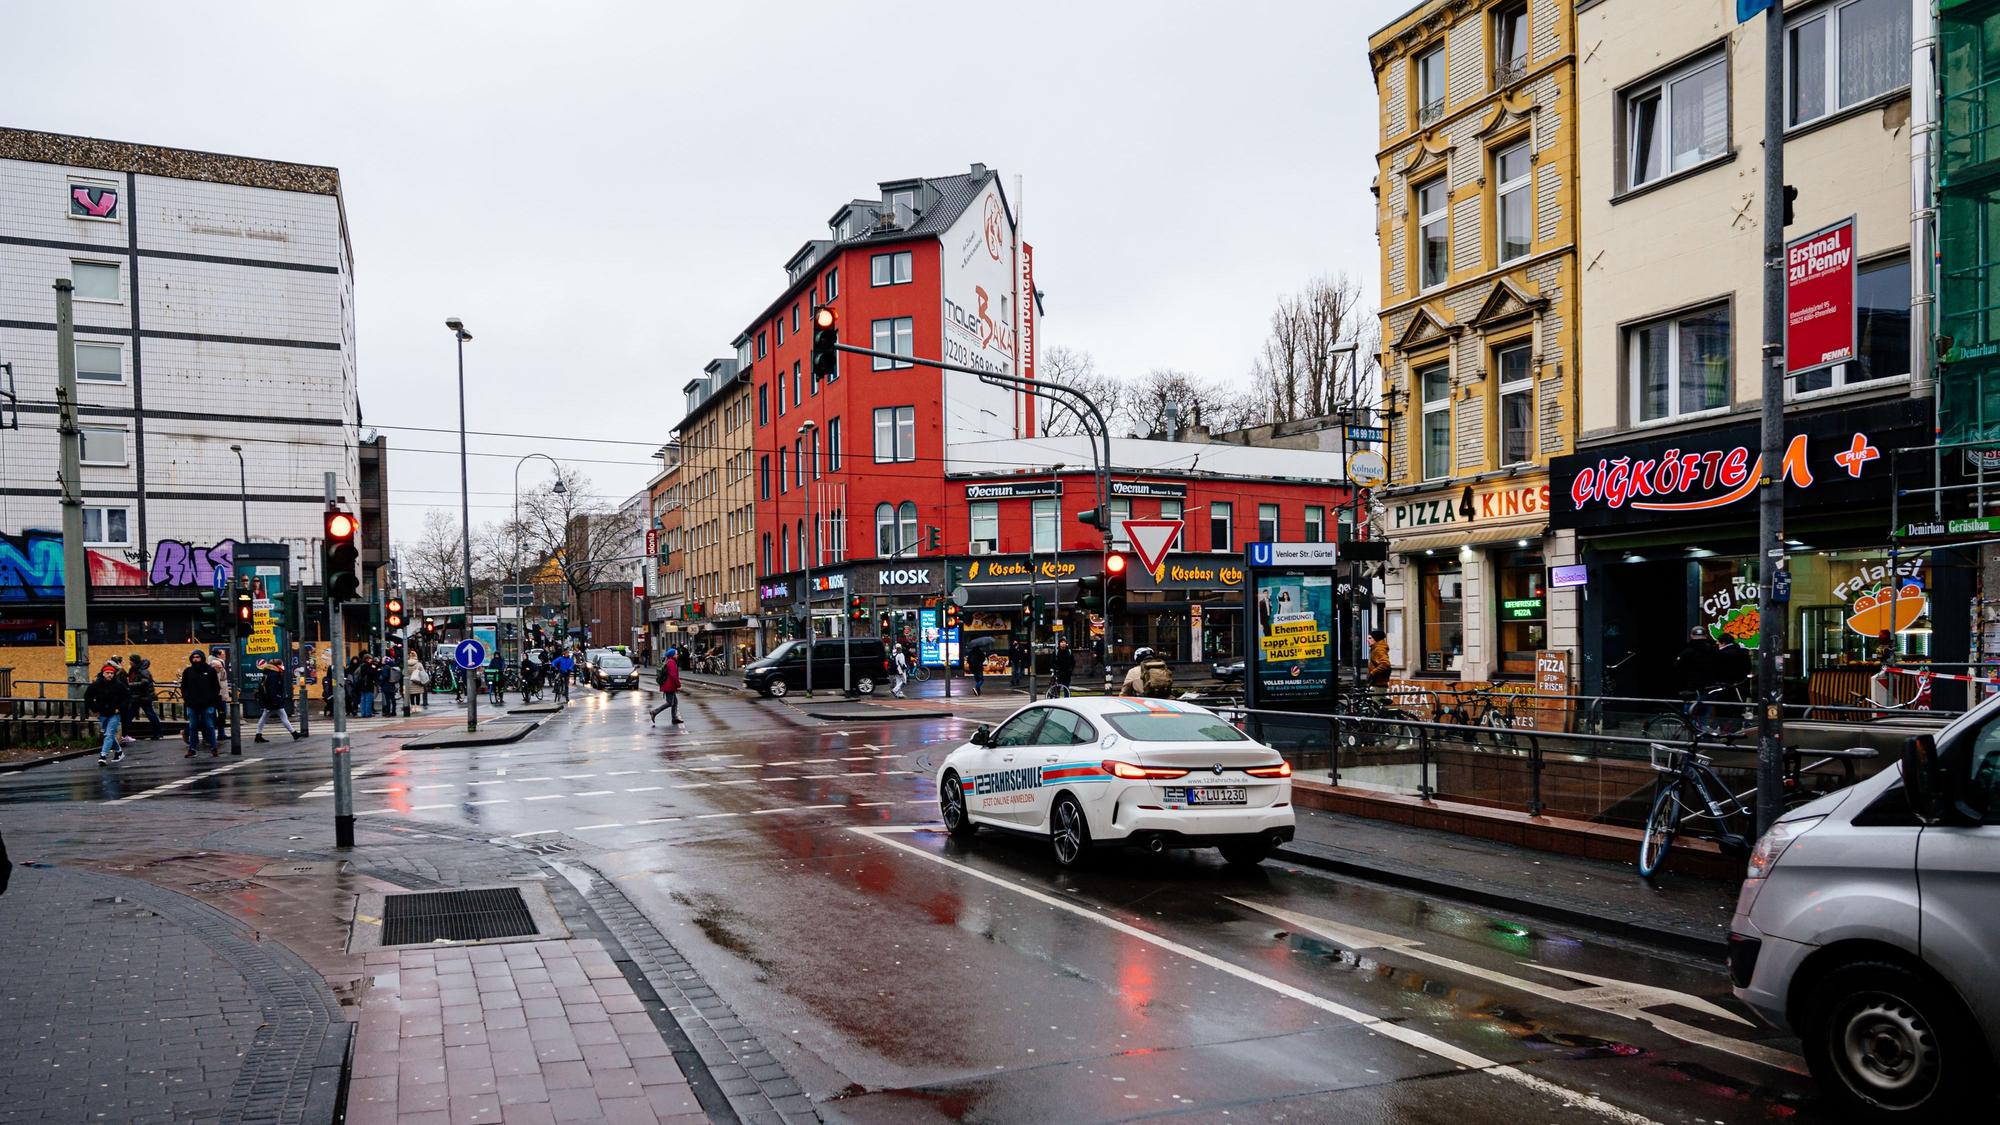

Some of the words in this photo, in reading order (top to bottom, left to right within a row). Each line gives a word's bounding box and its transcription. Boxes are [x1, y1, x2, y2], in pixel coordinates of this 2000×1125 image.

[1789, 230, 1841, 266] Erstmal
[1790, 264, 1806, 281] zu
[1807, 247, 1851, 275] Penny
[1960, 343, 1997, 359] Demirhan
[1845, 449, 1868, 463] PLUS
[968, 486, 1013, 497] Mecnun
[1113, 483, 1150, 494] Mecnun
[1395, 499, 1456, 528] PIZZA
[1459, 486, 1476, 522] 4
[1482, 485, 1550, 518] KINGS
[1908, 522, 1945, 536] Demirhan
[1948, 519, 1990, 533] Gerüstbau
[1254, 544, 1269, 564] U
[1275, 549, 1299, 558] Venloer
[1041, 560, 1076, 578] Kebap
[879, 569, 930, 585] KIOSK
[1703, 588, 1732, 617] Çiğ
[1513, 609, 1532, 617] PIZZA
[1274, 625, 1315, 634] Ehemann
[247, 645, 277, 653] haltung
[1263, 638, 1289, 649] zappt
[1304, 649, 1322, 657] weg
[1538, 658, 1565, 673] PIZZA
[1187, 777, 1249, 785] www.123fahrschule.de
[1163, 786, 1186, 798] 123
[1193, 790, 1200, 801] K
[1206, 789, 1220, 801] LU
[1221, 788, 1245, 801] 1230
[993, 795, 1010, 806] ONLINE
[1010, 793, 1035, 805] ANMELDEN
